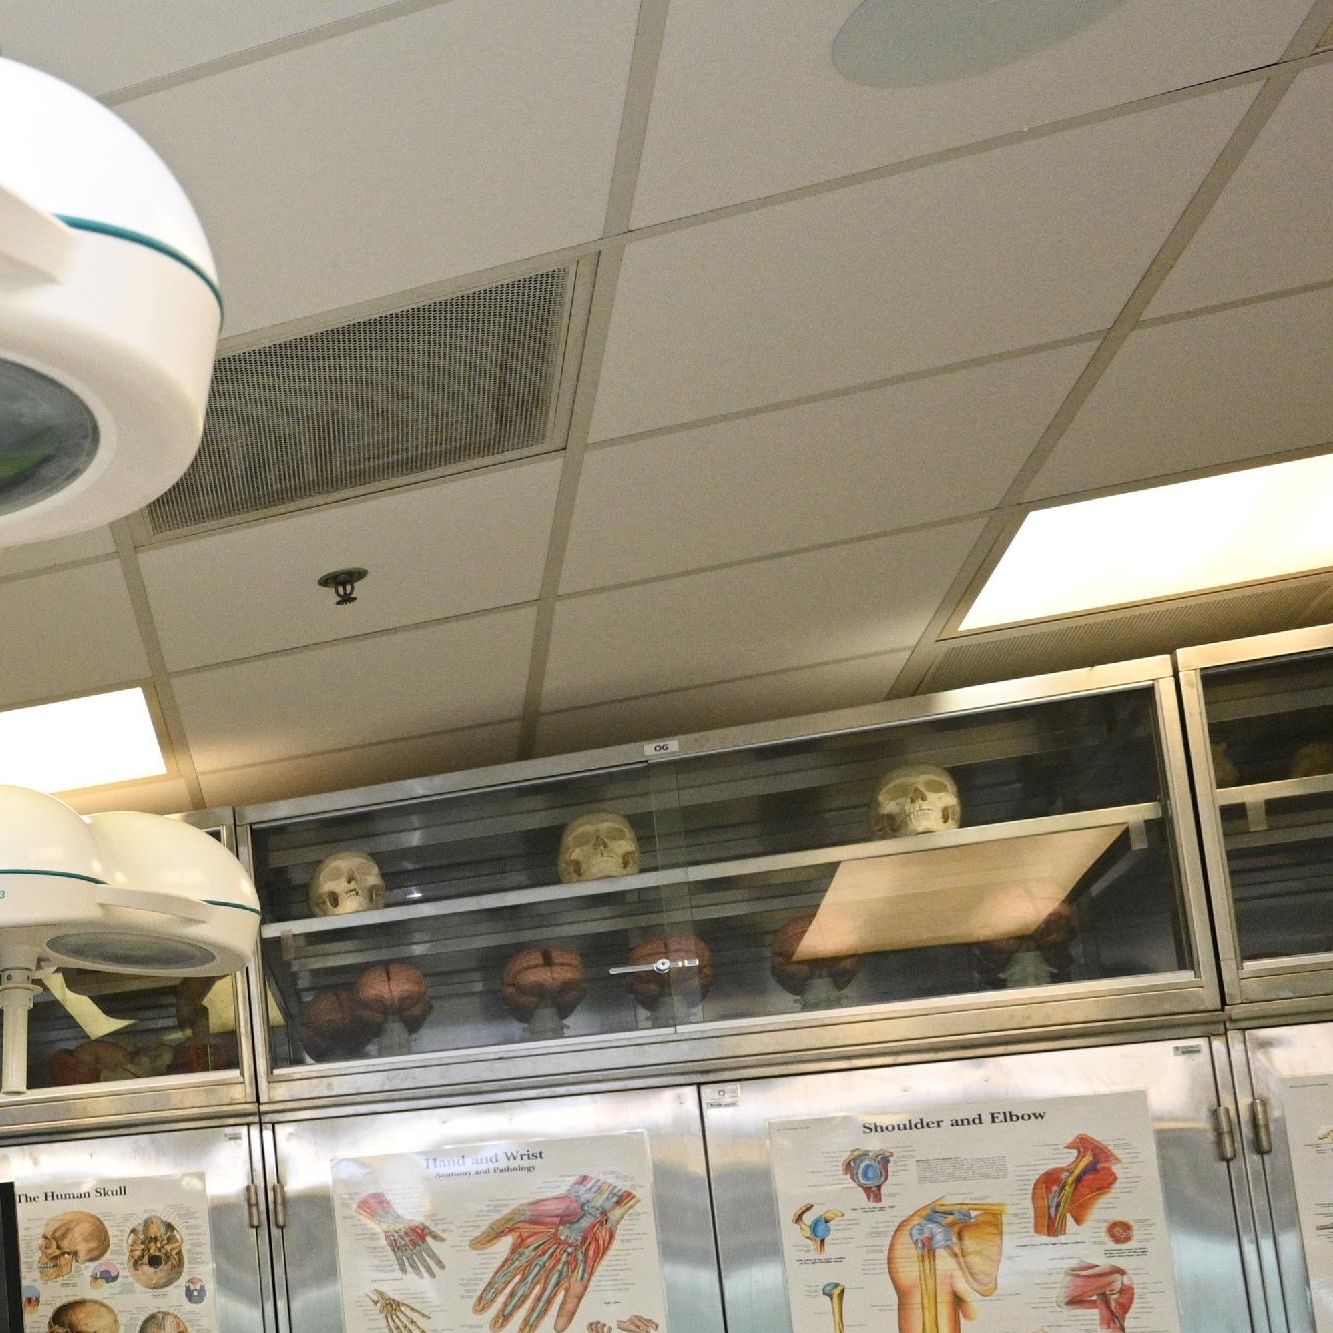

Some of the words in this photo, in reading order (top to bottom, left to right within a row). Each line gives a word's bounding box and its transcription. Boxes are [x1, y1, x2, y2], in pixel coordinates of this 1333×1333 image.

[862, 1119, 944, 1135] Shoulder
[950, 1113, 983, 1128] and
[989, 1108, 1047, 1124] Elbow
[425, 1156, 466, 1170] Hand
[471, 1152, 499, 1165] and
[503, 1148, 545, 1163] Wrist
[434, 1169, 473, 1179] Anatomy
[474, 1167, 491, 1176] and
[493, 1163, 537, 1175] Pathology
[17, 1192, 39, 1204] The
[44, 1187, 91, 1202] Human
[95, 1185, 128, 1198] Skull
